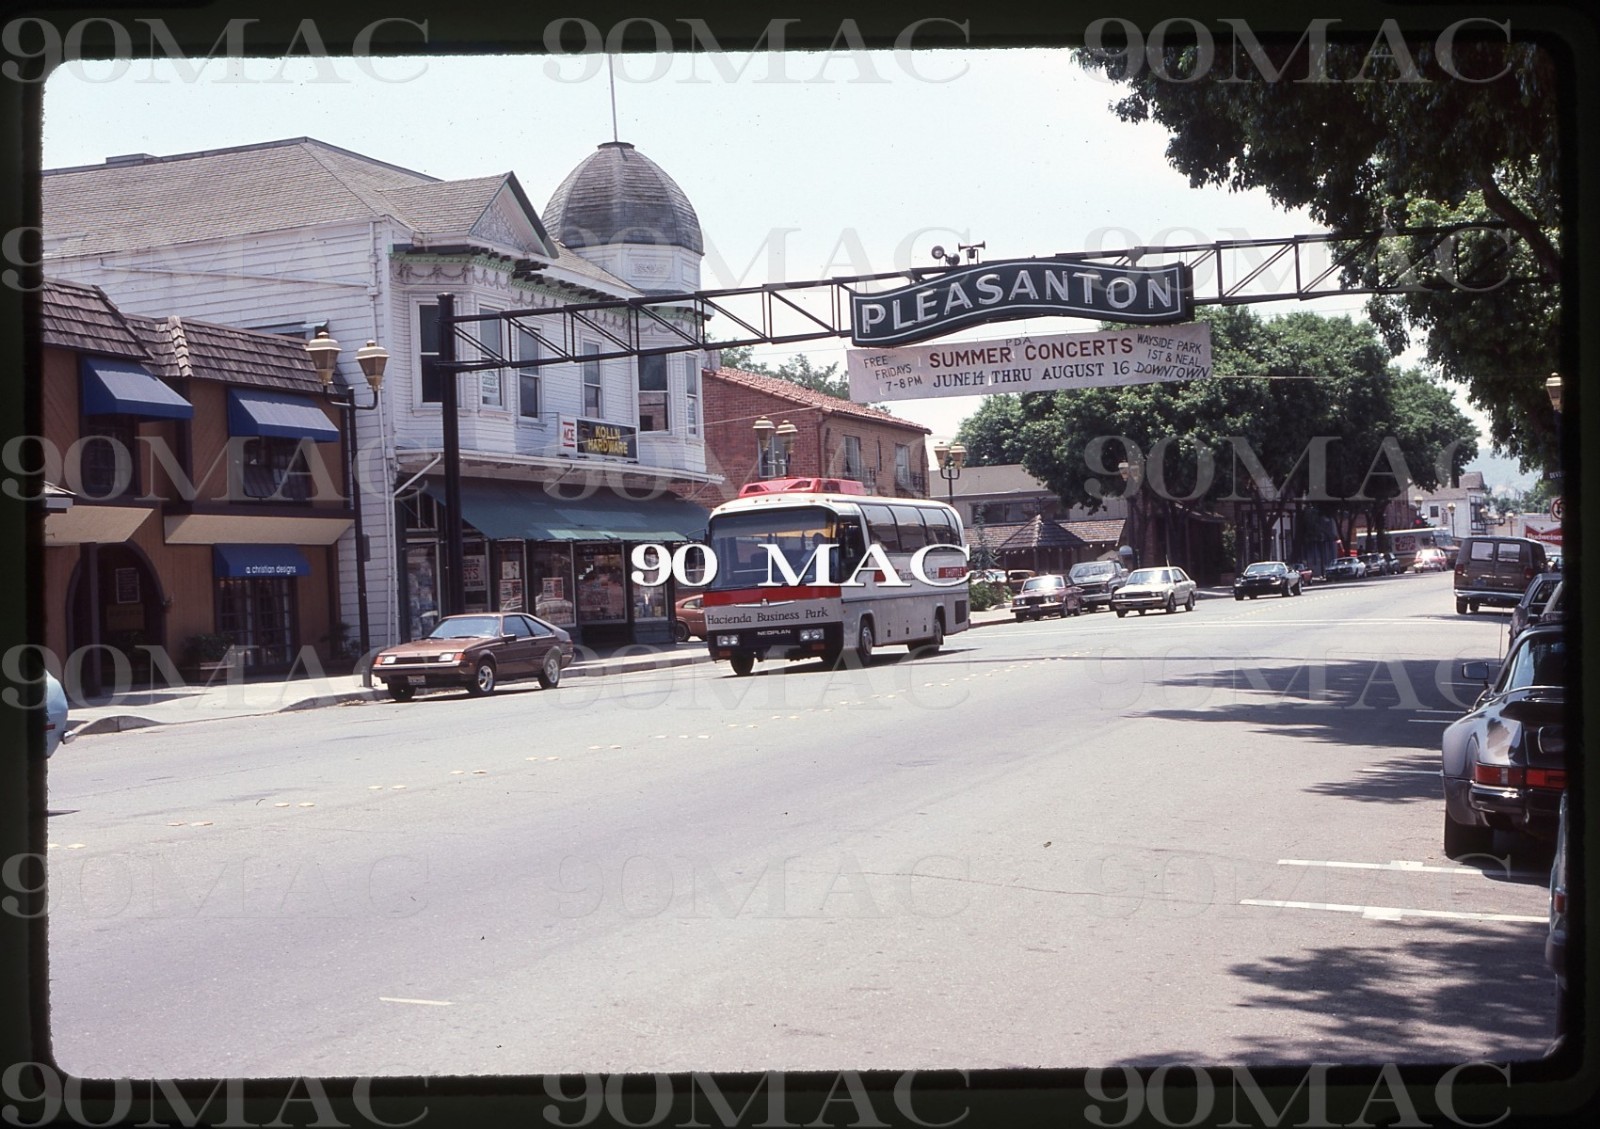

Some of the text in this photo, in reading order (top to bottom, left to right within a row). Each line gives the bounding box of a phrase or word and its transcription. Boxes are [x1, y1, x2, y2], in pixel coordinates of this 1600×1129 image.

[861, 269, 1171, 334] PLEASANTON
[1005, 337, 1032, 347] PDA
[1137, 333, 1202, 354] WAYSIDE PARK
[929, 337, 1133, 369] SUMMER CONCERTS
[1147, 349, 1201, 367] 1ST & NEAL
[875, 363, 912, 380] FRIDAYS
[991, 368, 1032, 383] THRU
[1042, 362, 1105, 380] AUGUST
[1113, 360, 1130, 376] 16
[1134, 361, 1210, 379] DOWNTOWN
[885, 375, 923, 392] 7-8 PM
[563, 428, 575, 441] ACE
[595, 425, 621, 440] KOLLN
[587, 438, 628, 454] HARDWARE
[251, 564, 275, 574] christian
[276, 564, 297, 575] designs
[707, 607, 829, 625] Hacienda Business Park
